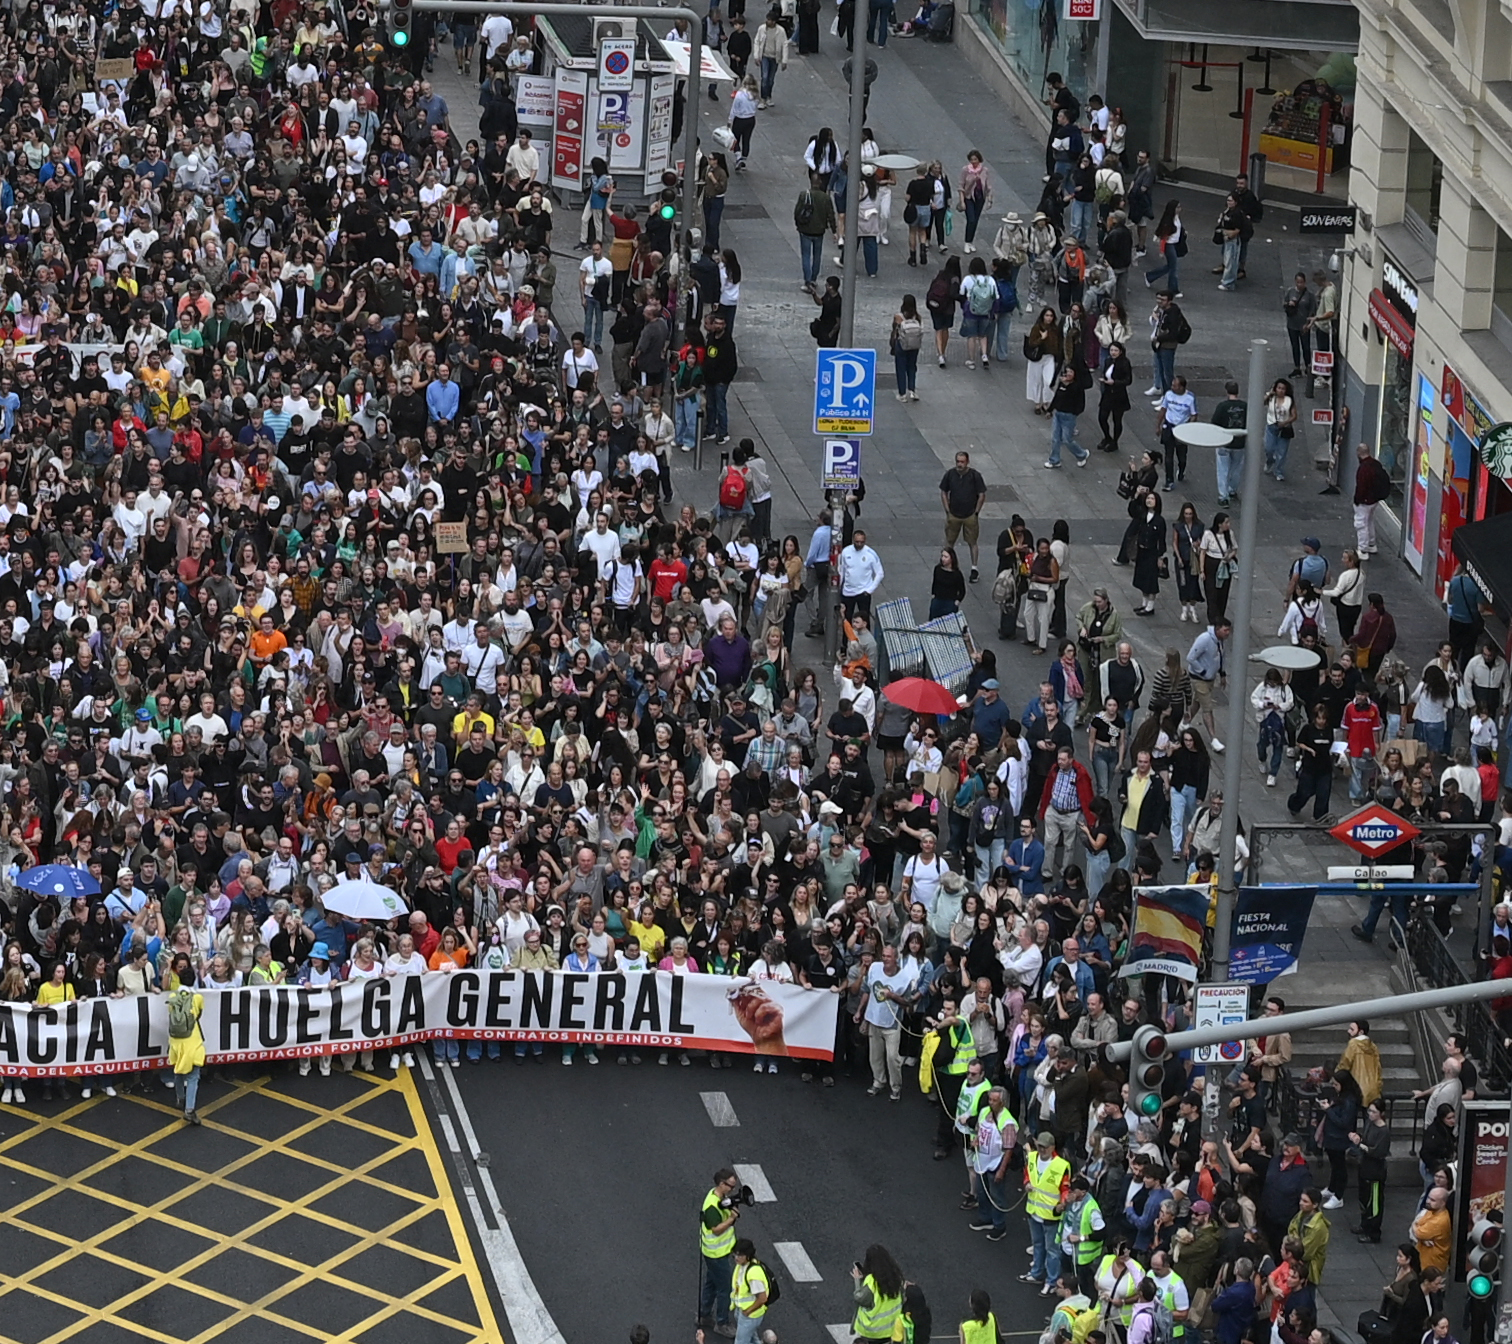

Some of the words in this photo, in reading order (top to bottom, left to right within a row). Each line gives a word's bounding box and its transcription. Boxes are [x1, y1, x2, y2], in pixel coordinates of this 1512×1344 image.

[827, 360, 866, 407] P
[819, 408, 850, 416] Público
[825, 440, 854, 474] P
[1466, 560, 1494, 604] STARBUCKS
[1356, 826, 1398, 840] Metro
[1354, 868, 1387, 878] Callao
[1238, 912, 1271, 923] FIESTA
[1236, 922, 1289, 935] NACIONAL
[1144, 962, 1179, 974] MADRID
[219, 975, 425, 1051] HUELGA
[446, 972, 695, 1035] GENERAL
[473, 1030, 569, 1041] CONTRATOS
[576, 1033, 682, 1046] INDEFINIDOS
[207, 1046, 324, 1063] EXPROPIACIÓN
[331, 1038, 394, 1052] FONDOS
[400, 1029, 454, 1044] BUITRE
[37, 1065, 67, 1076] DEL
[73, 1061, 151, 1075] ALQUILER
